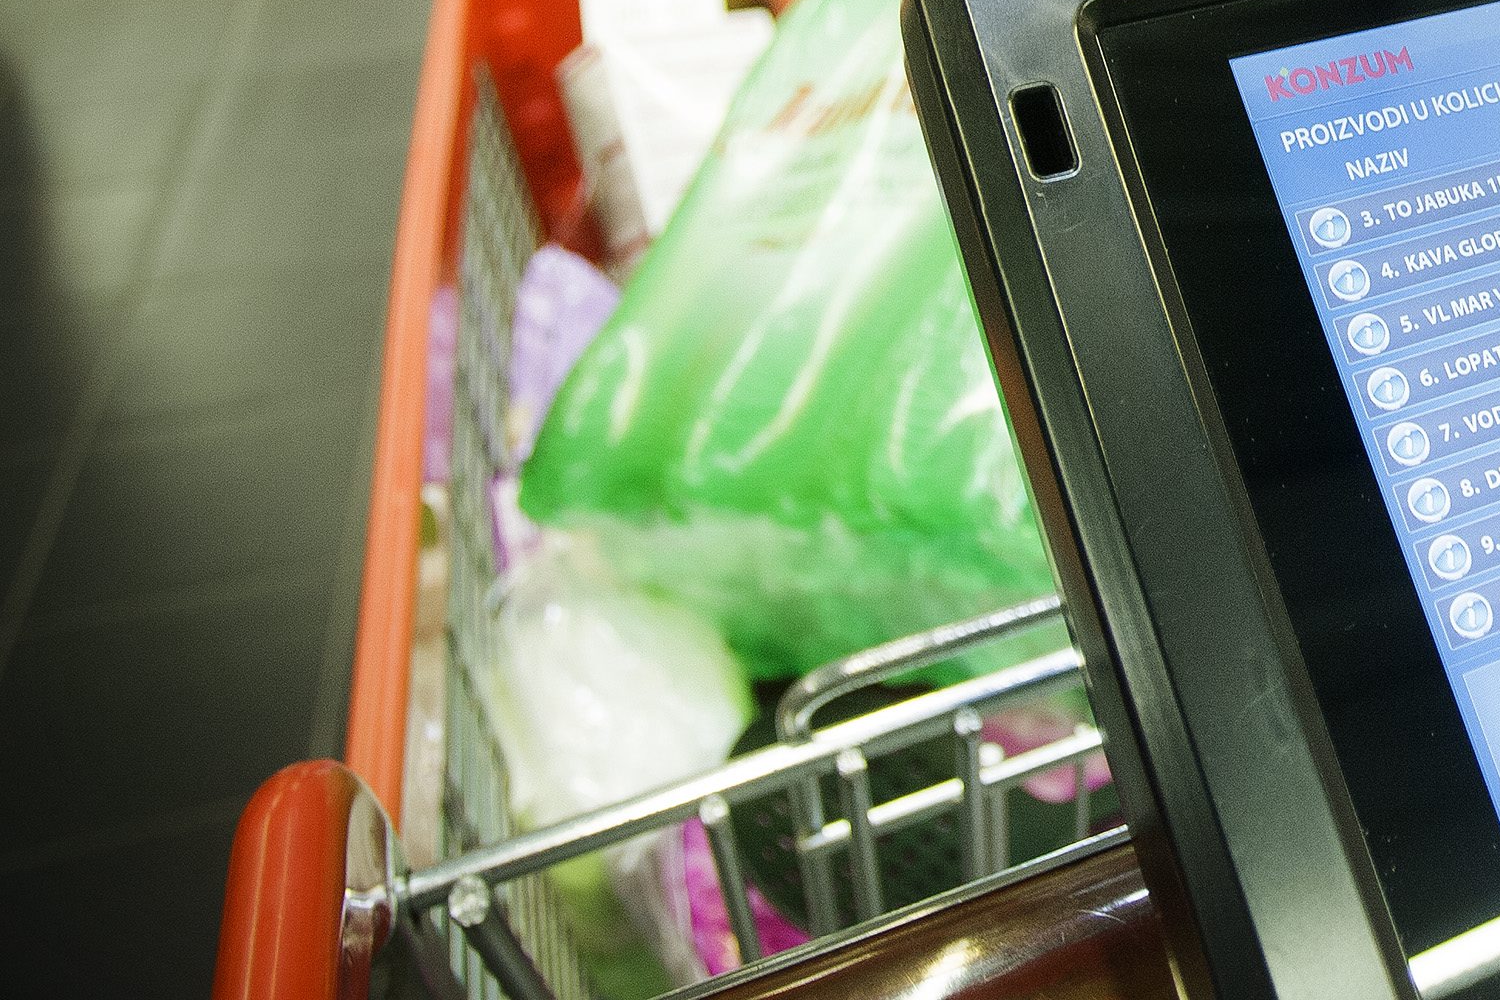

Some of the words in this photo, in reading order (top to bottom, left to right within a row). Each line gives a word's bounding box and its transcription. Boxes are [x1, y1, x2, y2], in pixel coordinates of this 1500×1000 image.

[1264, 46, 1414, 102] KONZUM
[1281, 104, 1410, 152] PROIZVODI
[1411, 99, 1430, 121] U
[1345, 148, 1409, 181] NAZIV
[1360, 211, 1380, 228] 3.
[1383, 201, 1412, 222] TO
[1415, 180, 1485, 215] JABUKA
[1381, 262, 1400, 280] 4.
[1404, 246, 1457, 275] KAVA
[1399, 314, 1420, 333] 5.
[1423, 306, 1451, 326] VL
[1452, 291, 1494, 317] MAR
[1419, 368, 1439, 387] 6.
[1437, 423, 1460, 442] 7.
[1460, 480, 1480, 498] 8.
